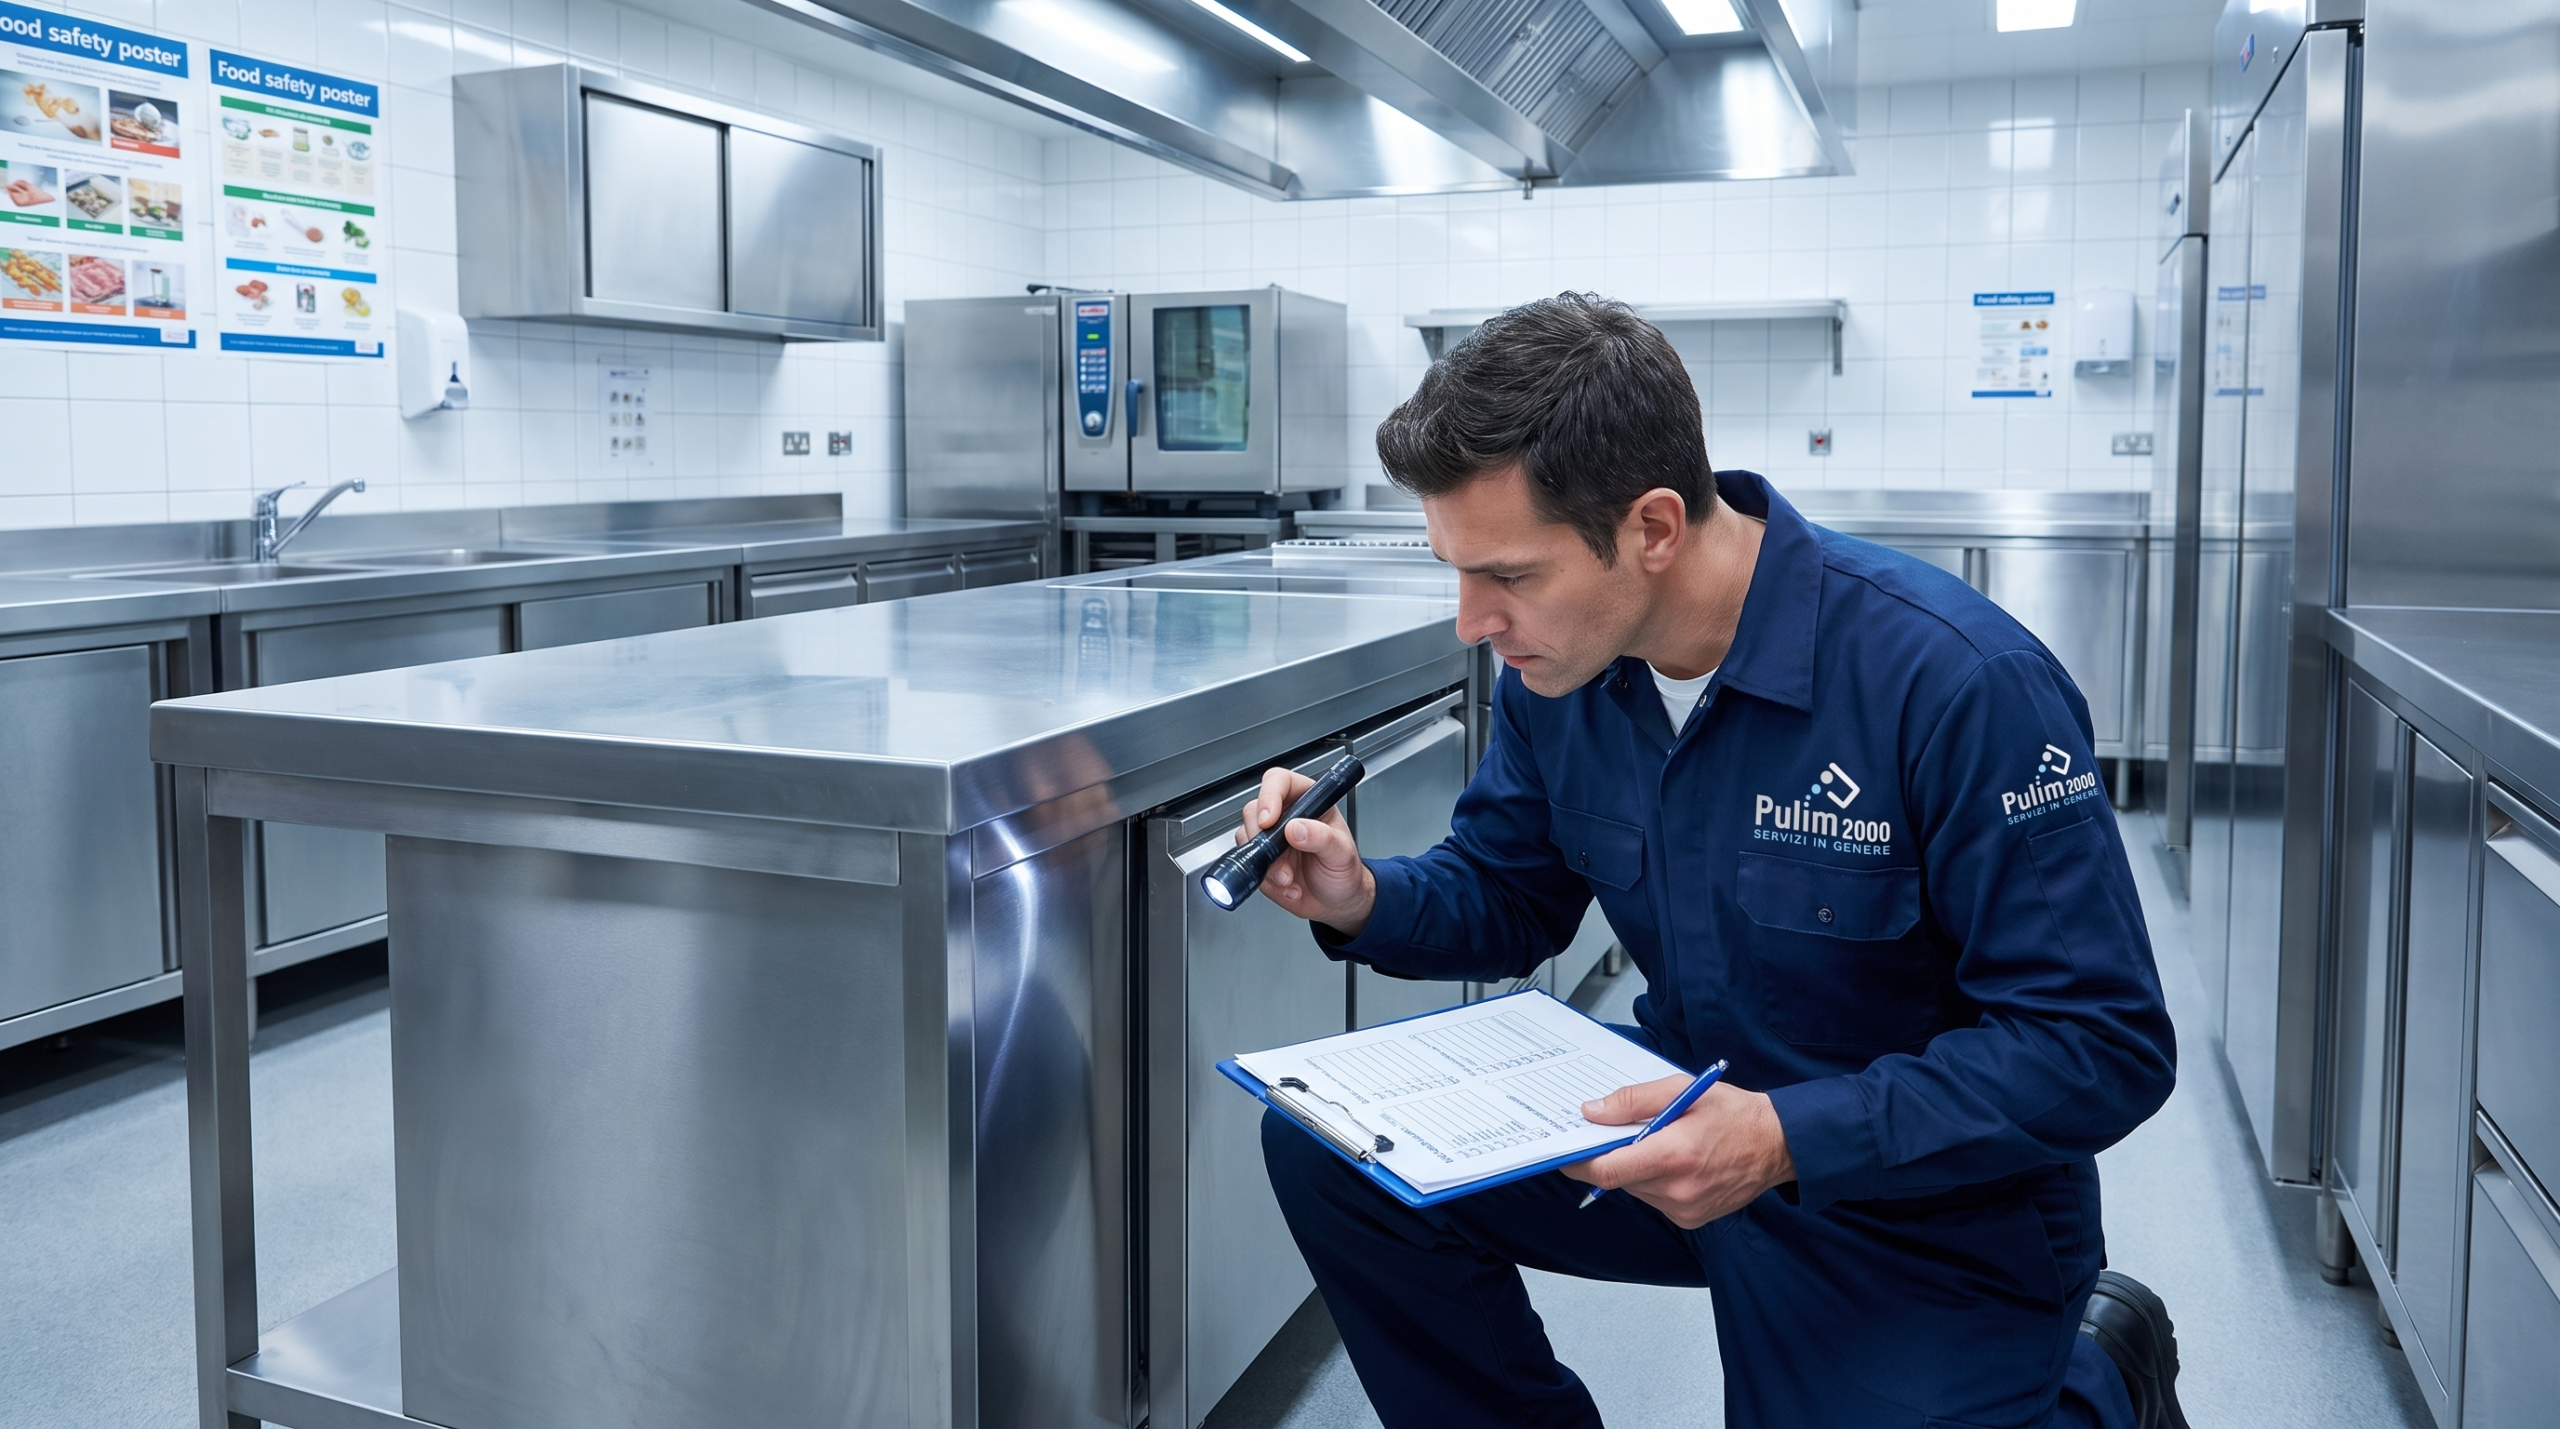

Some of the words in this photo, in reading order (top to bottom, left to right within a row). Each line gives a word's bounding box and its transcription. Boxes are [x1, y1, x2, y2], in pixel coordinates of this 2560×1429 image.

[0, 16, 42, 39] ood
[48, 26, 113, 58] safety
[118, 41, 182, 68] poster
[218, 60, 261, 85] Food
[265, 73, 316, 100] safety
[320, 85, 371, 108] poster
[2001, 781, 2066, 815] Pulim
[2066, 772, 2096, 795] 2000
[2007, 806, 2047, 825] SERVIZI
[2050, 801, 2060, 811] IN
[2063, 787, 2099, 806] GENERE
[1755, 794, 1838, 837] Pulim
[1842, 818, 1891, 843] 2000
[1753, 829, 1807, 845] SERVIZI
[1813, 837, 1827, 849] IN
[1833, 841, 1891, 856] GENERE
